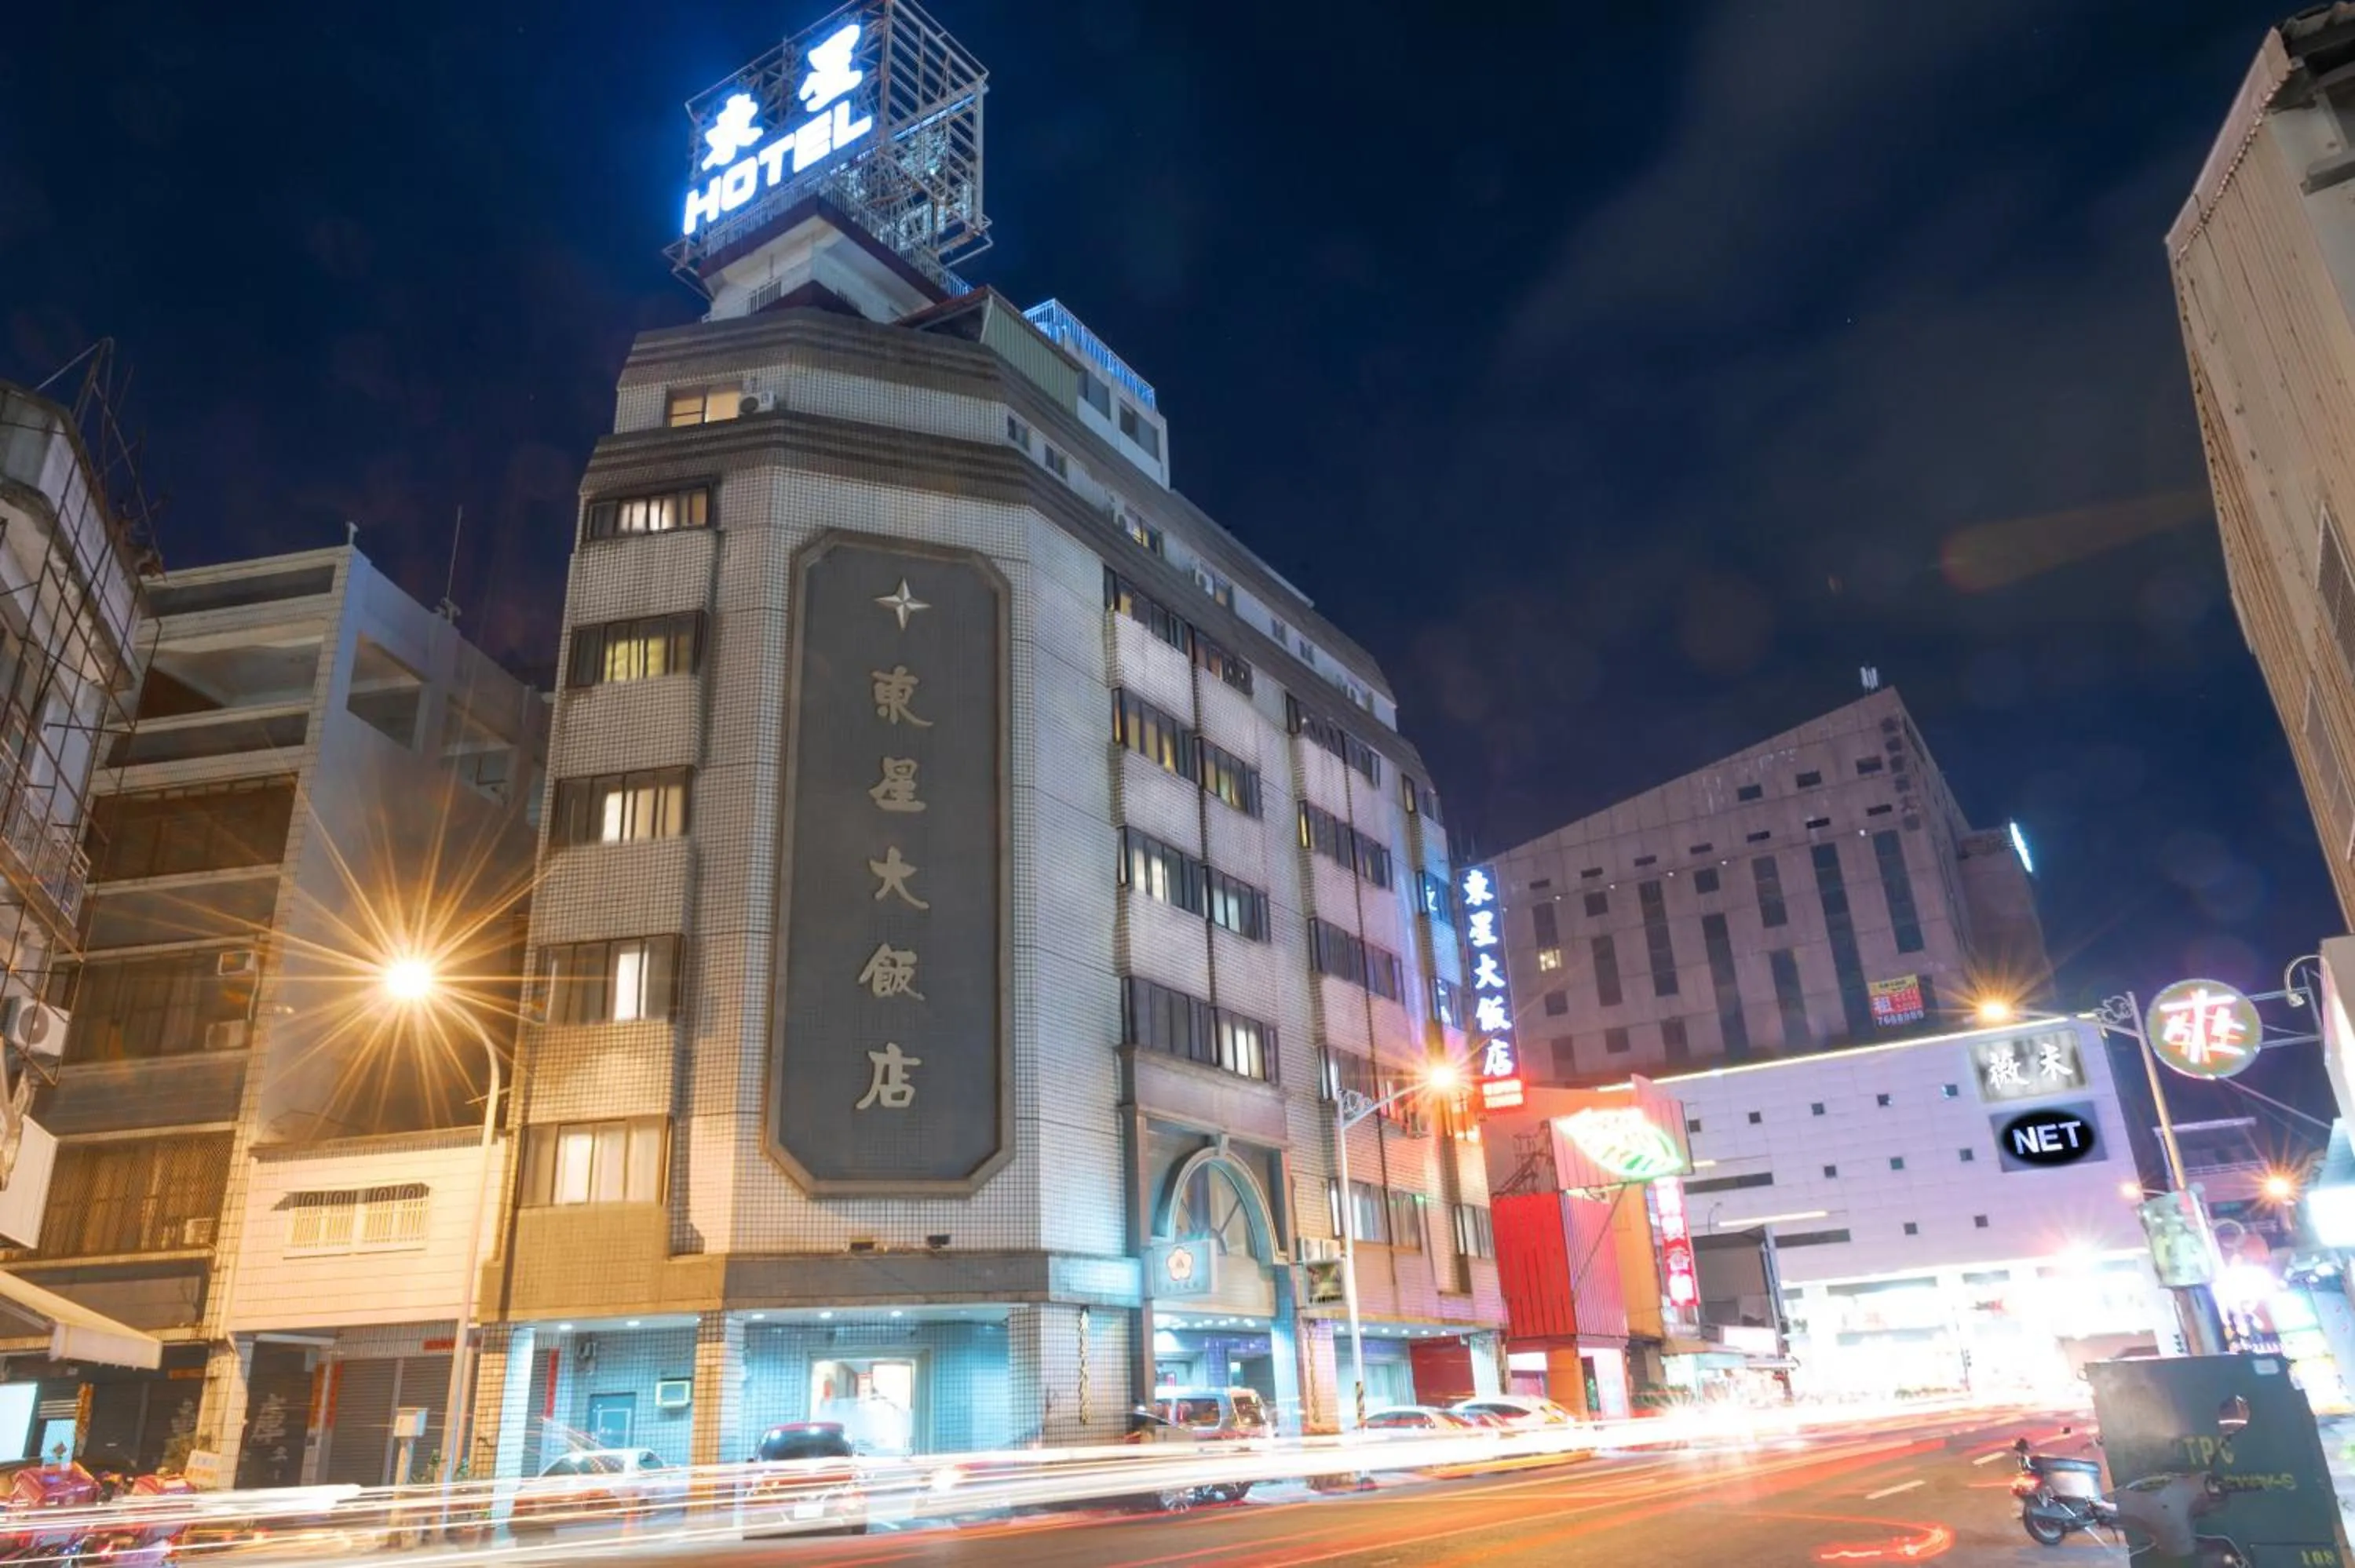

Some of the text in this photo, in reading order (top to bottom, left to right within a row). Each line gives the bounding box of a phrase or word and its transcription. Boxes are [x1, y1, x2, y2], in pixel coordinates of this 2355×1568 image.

[683, 100, 872, 236] HOTEL
[855, 665, 933, 1111] 東星大飯店
[1463, 869, 1514, 1078] 東星大飯店
[2011, 1120, 2082, 1155] NET
